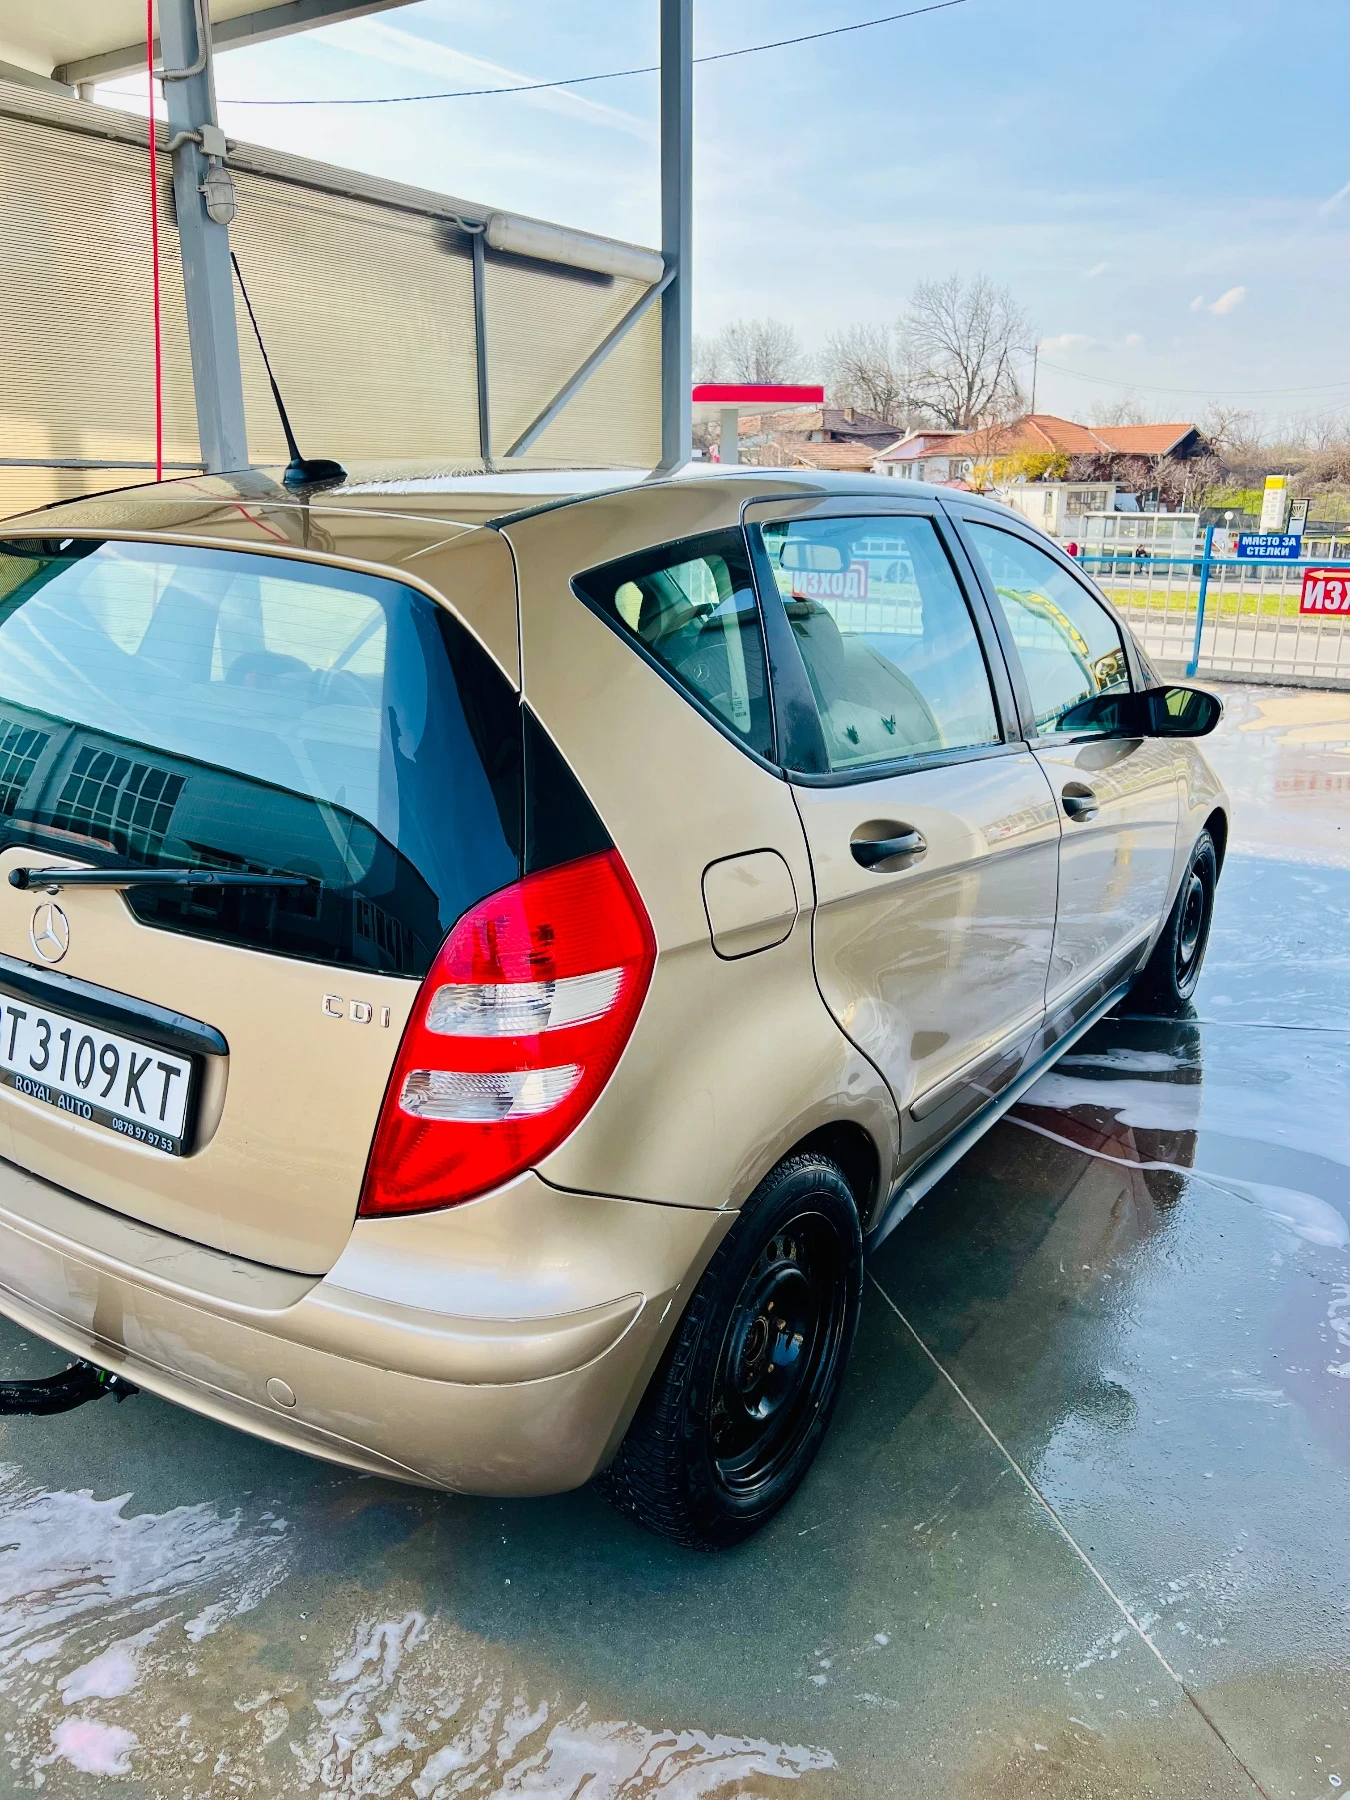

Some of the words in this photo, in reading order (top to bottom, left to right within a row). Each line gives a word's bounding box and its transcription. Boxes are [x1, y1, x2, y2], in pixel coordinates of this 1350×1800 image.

[1242, 536, 1279, 546] МЯСТО
[1282, 536, 1296, 546] ЗА
[1246, 546, 1290, 556] СТЕЛКИ
[793, 570, 859, 598] ИЗХОД
[321, 993, 391, 1028] CDI
[15, 1075, 53, 1104] ROYAL
[57, 1094, 93, 1120] AUTO
[112, 1117, 134, 1136] 0878
[135, 1128, 147, 1140] 97
[148, 1132, 160, 1146] 97
[161, 1139, 173, 1152] 53
